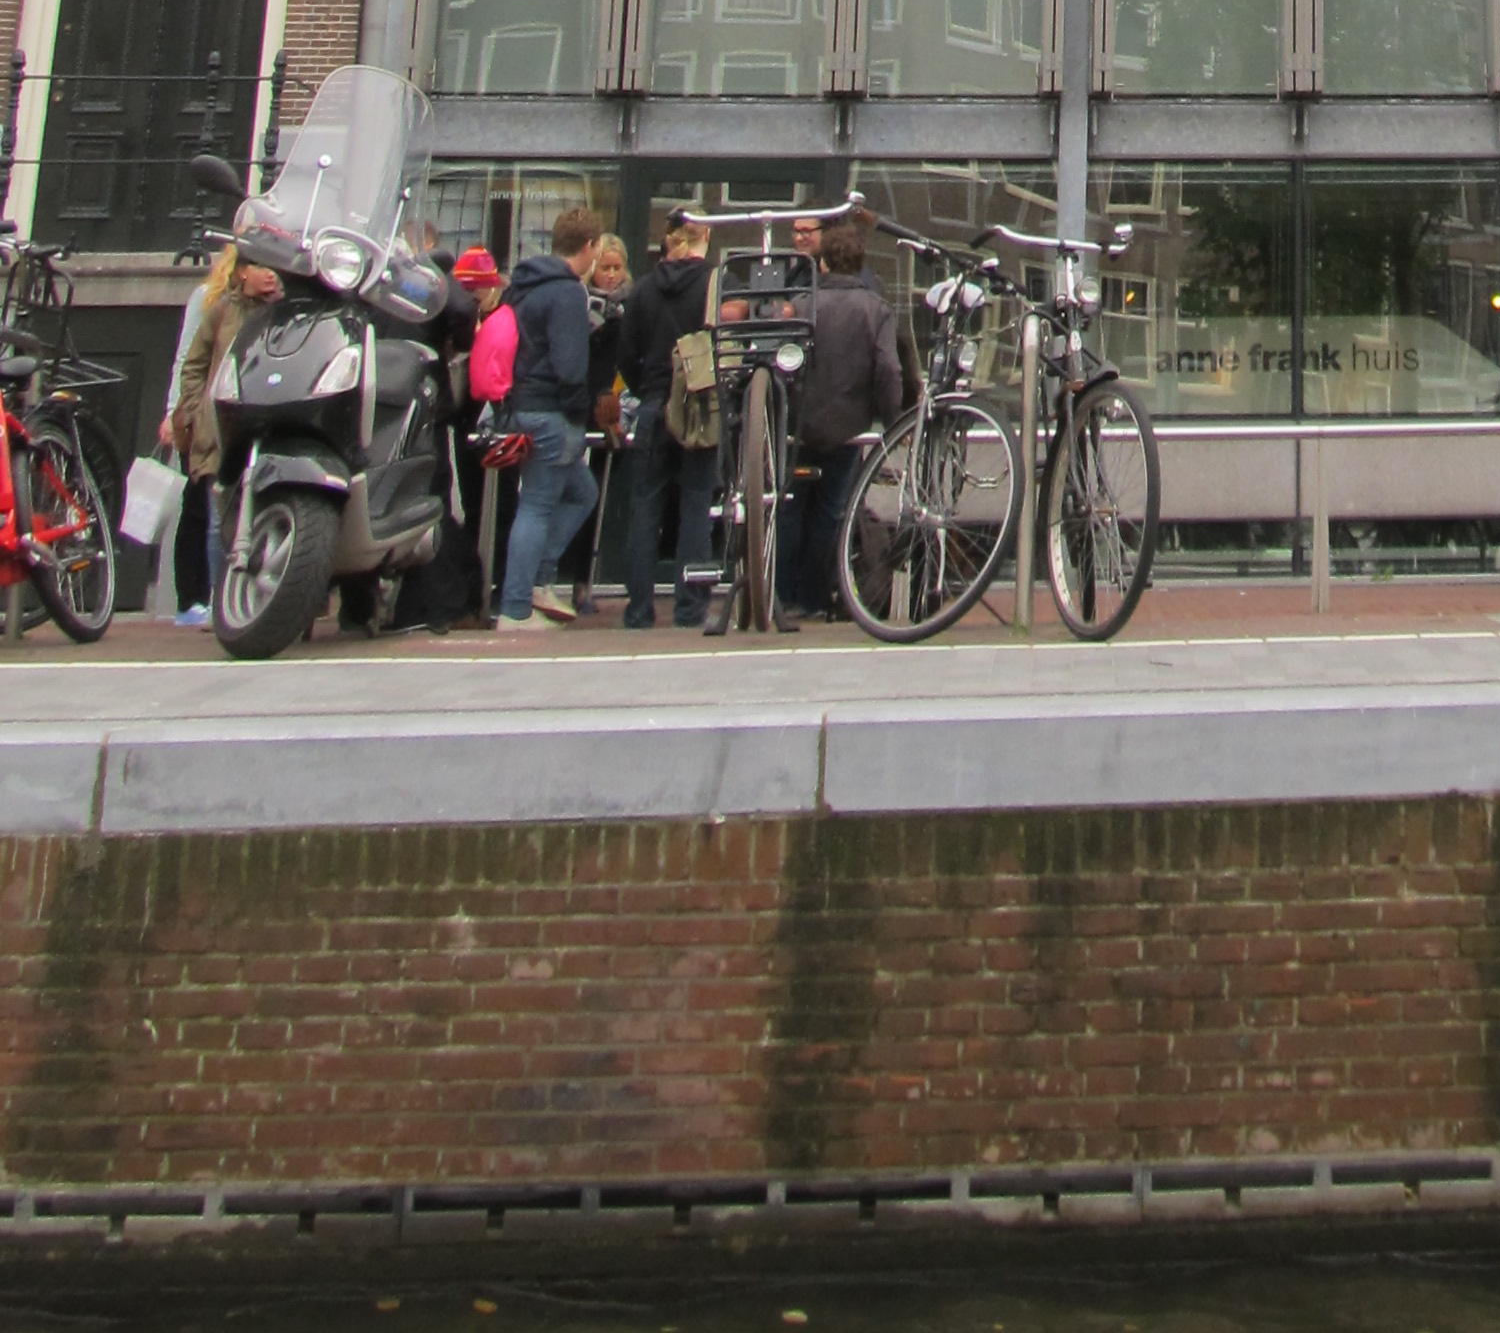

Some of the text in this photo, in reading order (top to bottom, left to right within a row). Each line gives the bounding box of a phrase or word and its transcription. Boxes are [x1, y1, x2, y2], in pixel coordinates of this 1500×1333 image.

[1156, 342, 1420, 372] anne frank huis
